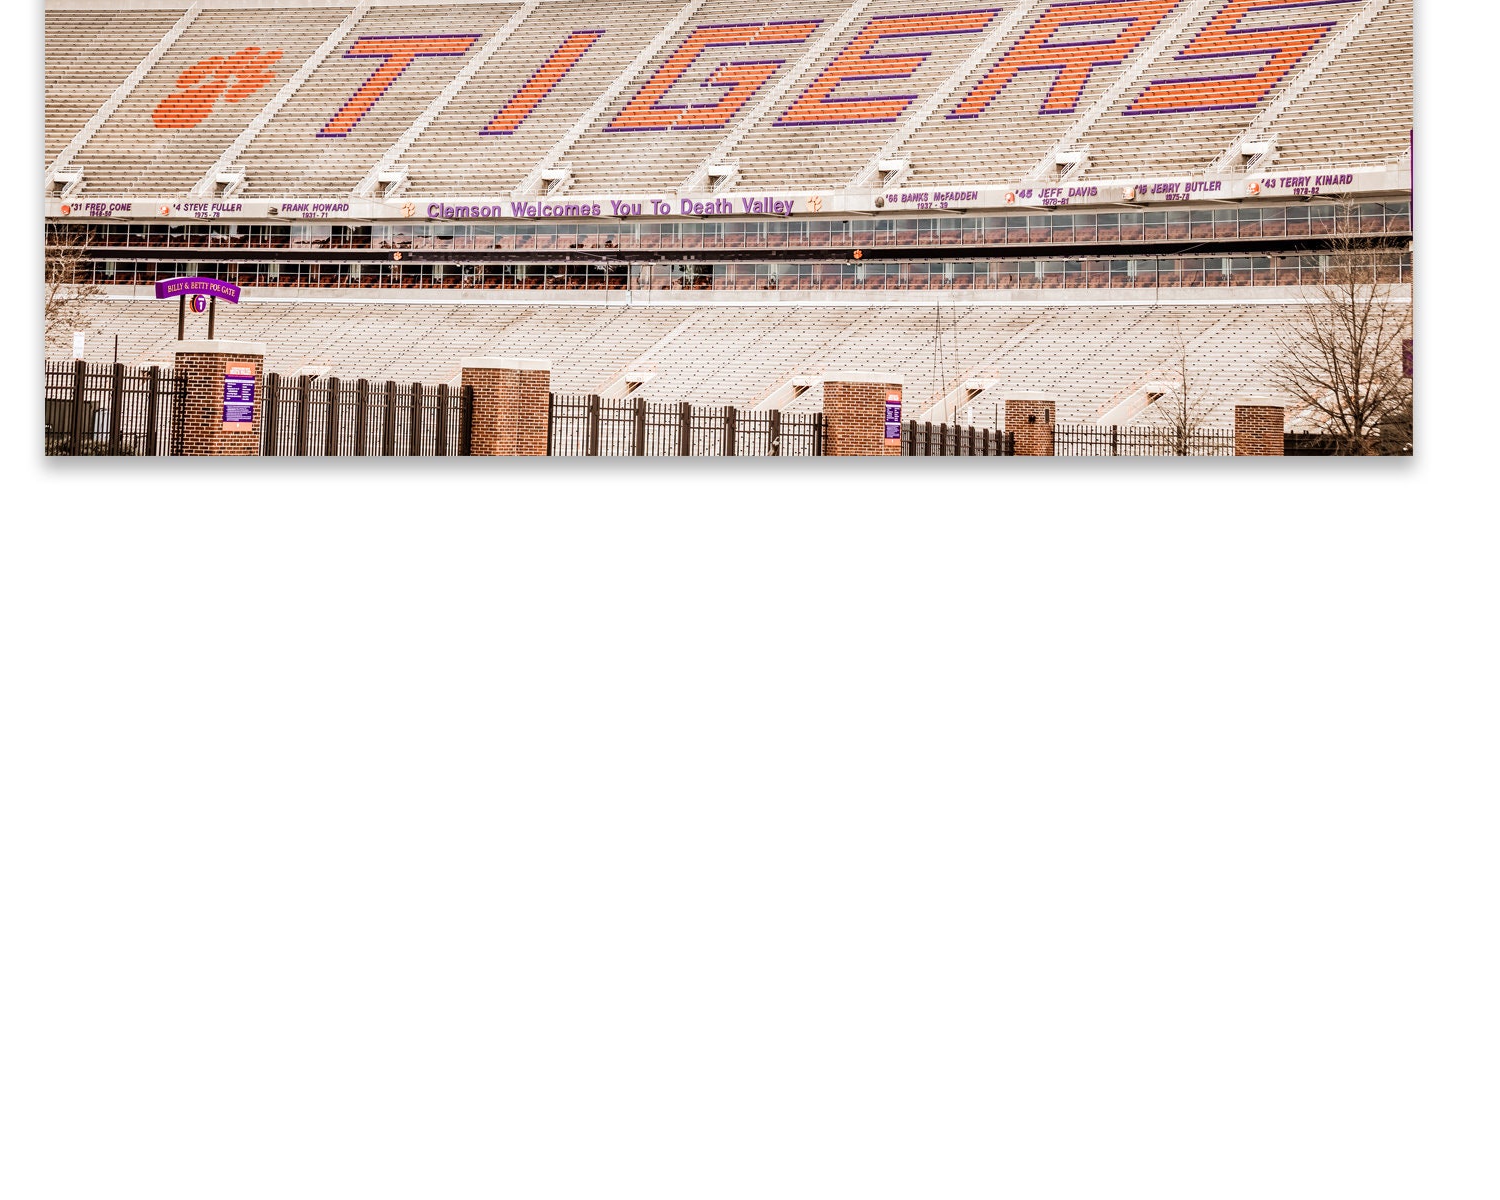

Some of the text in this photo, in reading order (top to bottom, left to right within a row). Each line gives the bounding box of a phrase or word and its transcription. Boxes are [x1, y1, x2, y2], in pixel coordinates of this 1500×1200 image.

[1280, 176, 1311, 187] TERRY
[1315, 174, 1353, 186] KINARD
[1038, 188, 1063, 198] JEFF
[1068, 186, 1098, 197] DAVIS
[1151, 182, 1181, 194] JERRY
[1185, 181, 1222, 192] BUTLER
[901, 193, 929, 203] BANKS
[933, 191, 978, 202] McFADDEN
[85, 203, 107, 211] FRED
[109, 203, 132, 211] CONE
[183, 203, 208, 212] STEVE
[211, 203, 242, 212] FULLER
[282, 203, 349, 212] FRANK HOWARD
[427, 197, 795, 218] Clemson Welcomes You To Death Valley
[167, 282, 183, 293] BILLY
[184, 281, 190, 290] &
[221, 286, 236, 298] GATE
